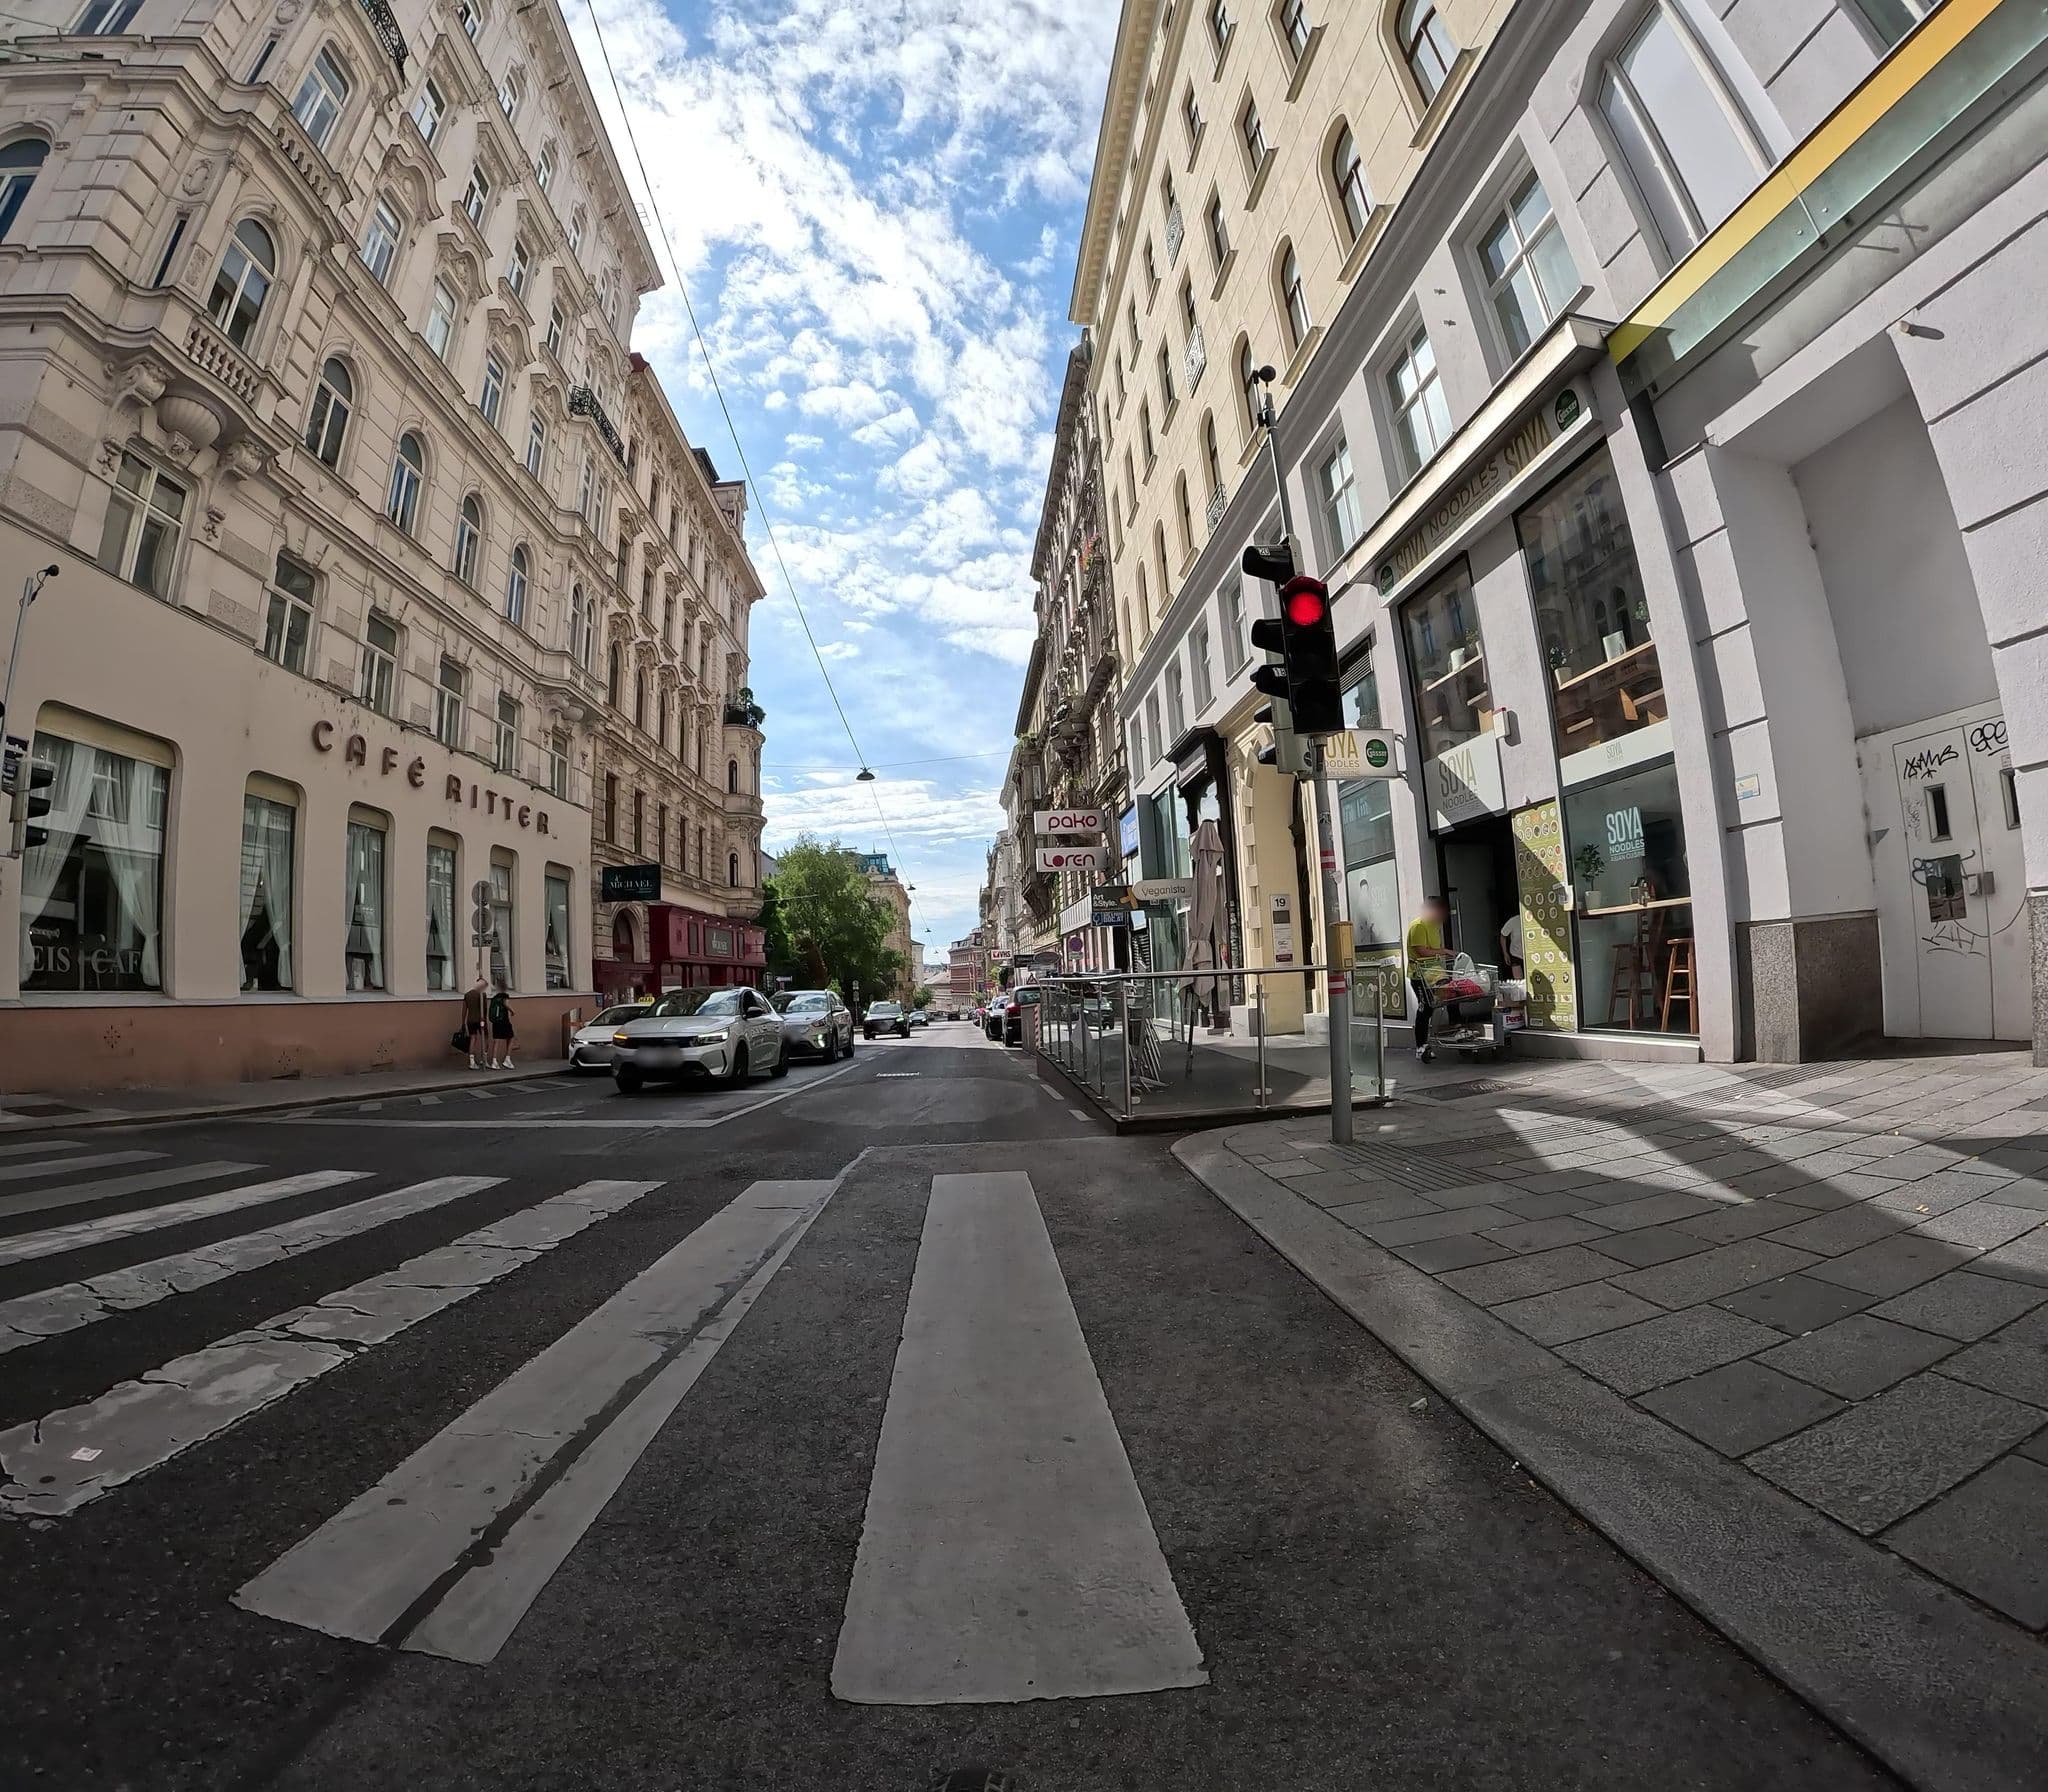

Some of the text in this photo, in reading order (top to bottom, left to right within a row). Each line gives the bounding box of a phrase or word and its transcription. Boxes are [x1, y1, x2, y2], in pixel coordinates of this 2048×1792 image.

[1429, 458, 1500, 537] NOODLES
[1503, 411, 1552, 481] SOYA
[1325, 730, 1359, 759] OYA
[311, 719, 549, 835] CAFÉ RITTER
[1439, 748, 1477, 798] SOYA
[1048, 812, 1098, 832] pako
[1605, 806, 1644, 845] SOYA
[1609, 838, 1645, 855] NOODLES
[1141, 885, 1186, 897] Veganista
[1274, 897, 1286, 908] 19
[32, 945, 71, 974] EIS
[1000, 950, 1011, 958] VHS
